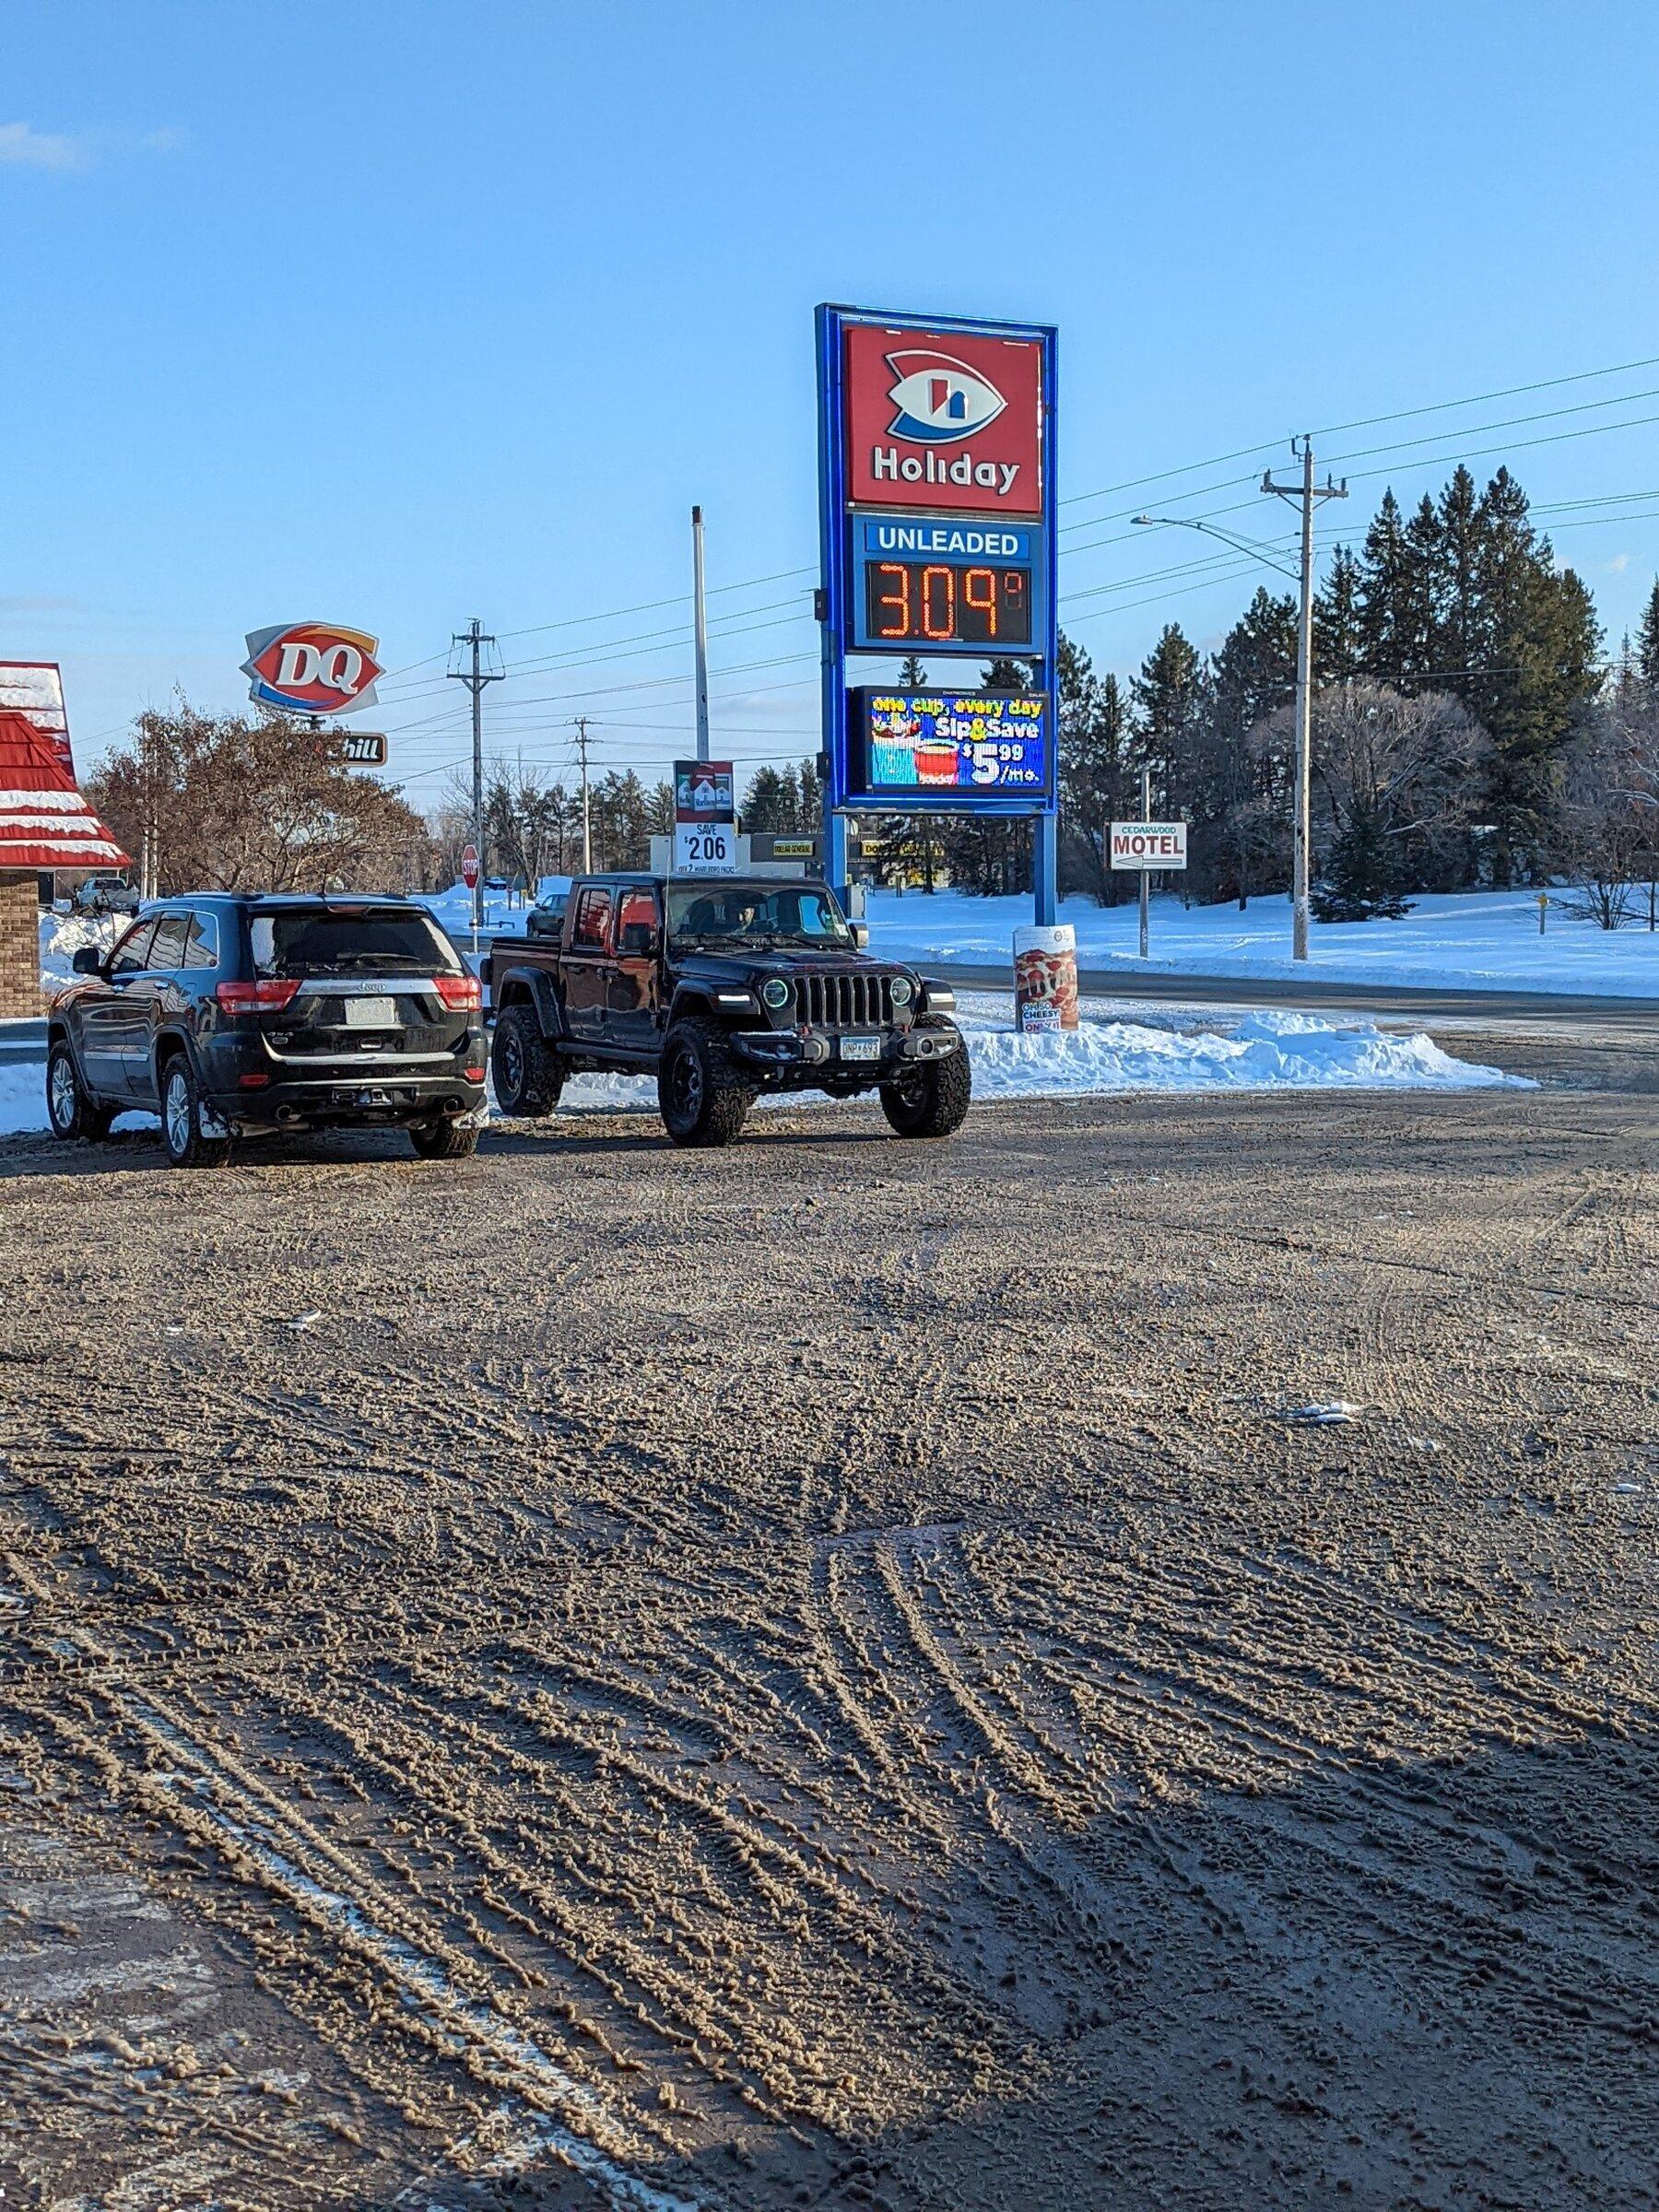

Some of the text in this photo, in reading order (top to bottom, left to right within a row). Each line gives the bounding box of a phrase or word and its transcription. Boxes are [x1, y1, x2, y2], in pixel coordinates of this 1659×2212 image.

[874, 446, 1019, 495] Holiday
[878, 527, 1018, 555] UNLEADED
[276, 643, 362, 694] DQ
[955, 700, 1004, 717] every
[1008, 699, 1043, 718] day
[336, 738, 379, 759] hill
[697, 824, 717, 835] SAVE
[1122, 826, 1177, 834] CEDARWOOD
[684, 836, 725, 860] $2.06
[1113, 835, 1184, 854] MOTEL
[463, 859, 477, 876] STOP
[357, 982, 385, 993] Jeep
[1025, 1022, 1051, 1031] ONY
